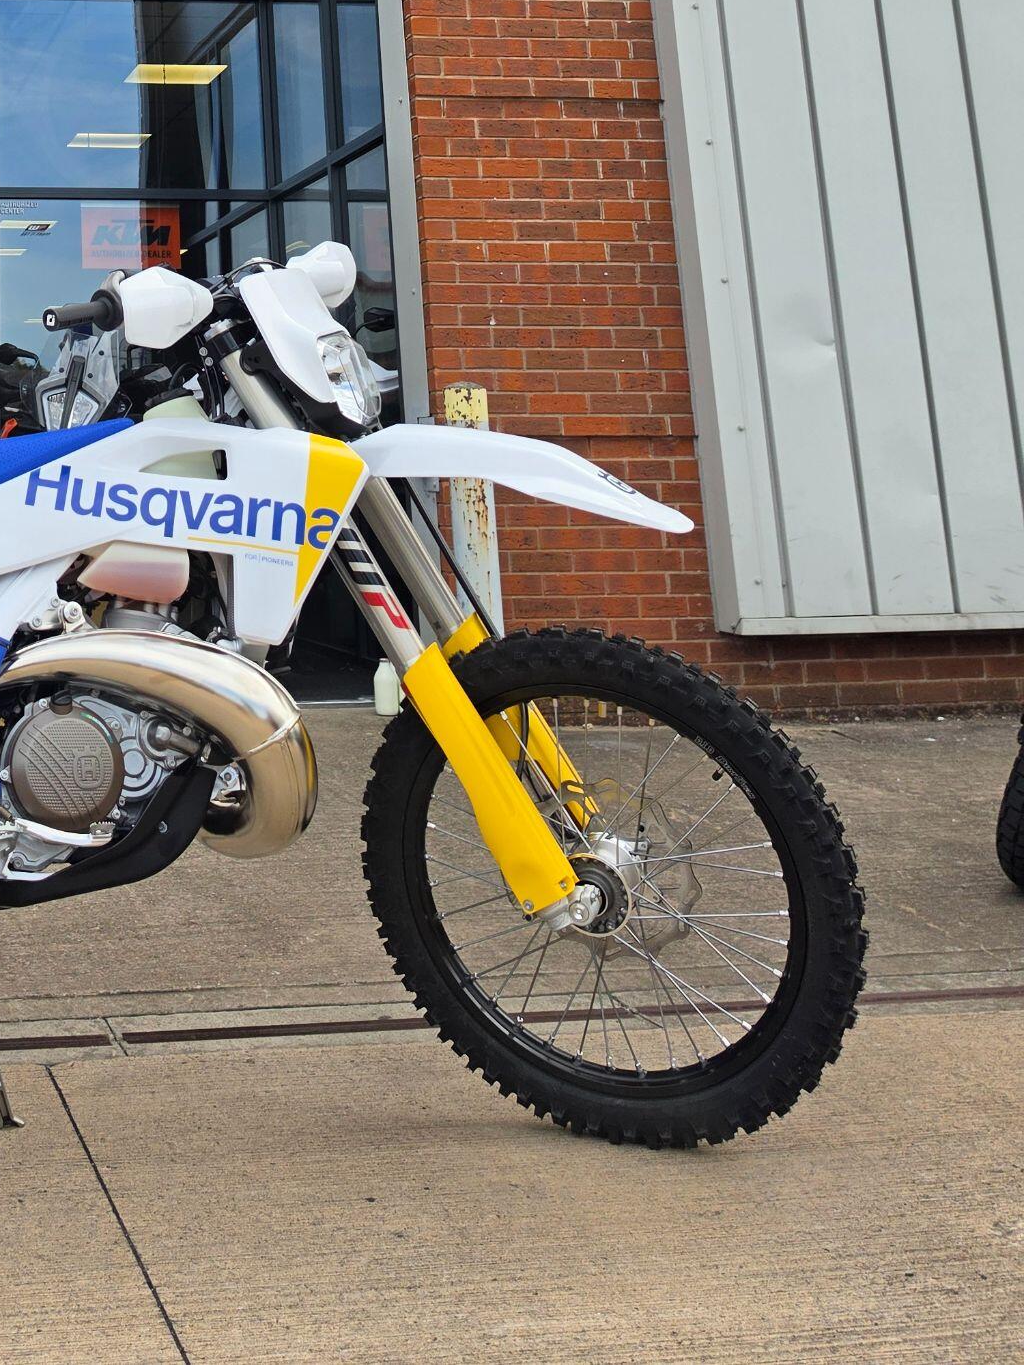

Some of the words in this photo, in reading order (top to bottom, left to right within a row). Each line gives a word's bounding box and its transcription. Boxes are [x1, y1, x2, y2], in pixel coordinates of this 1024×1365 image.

[91, 219, 171, 246] KTM
[143, 250, 172, 259] DEALER
[24, 465, 342, 550] Husqvarna
